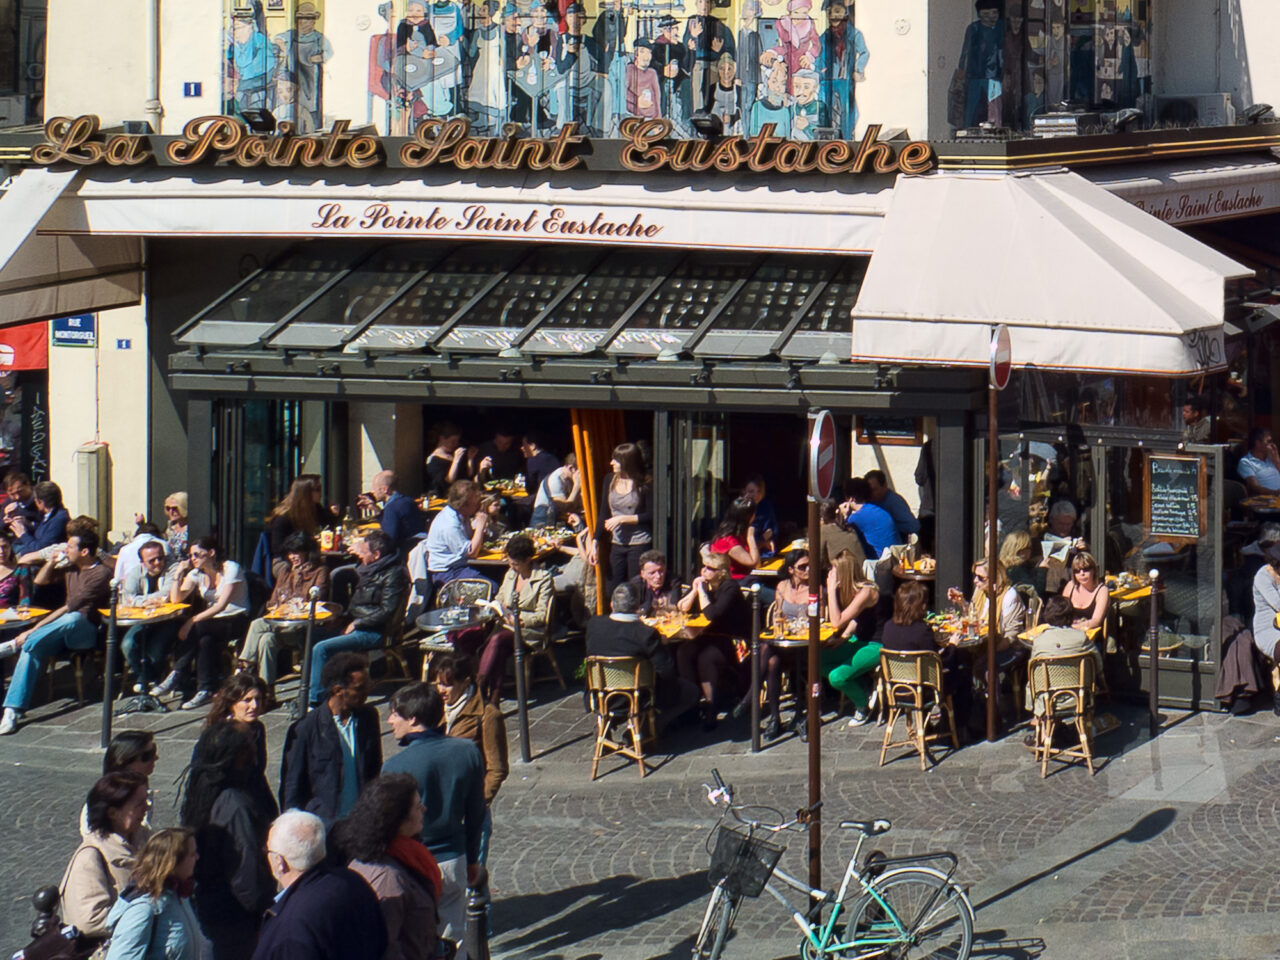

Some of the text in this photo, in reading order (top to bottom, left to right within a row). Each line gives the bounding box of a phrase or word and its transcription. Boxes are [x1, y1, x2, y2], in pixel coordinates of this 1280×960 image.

[31, 114, 937, 175] La Pointe Saint Eustache
[1175, 193, 1213, 219] Saint
[1214, 187, 1263, 213] Eustache
[311, 203, 663, 238] La Pointe Saint Eustache
[67, 318, 82, 328] RUE
